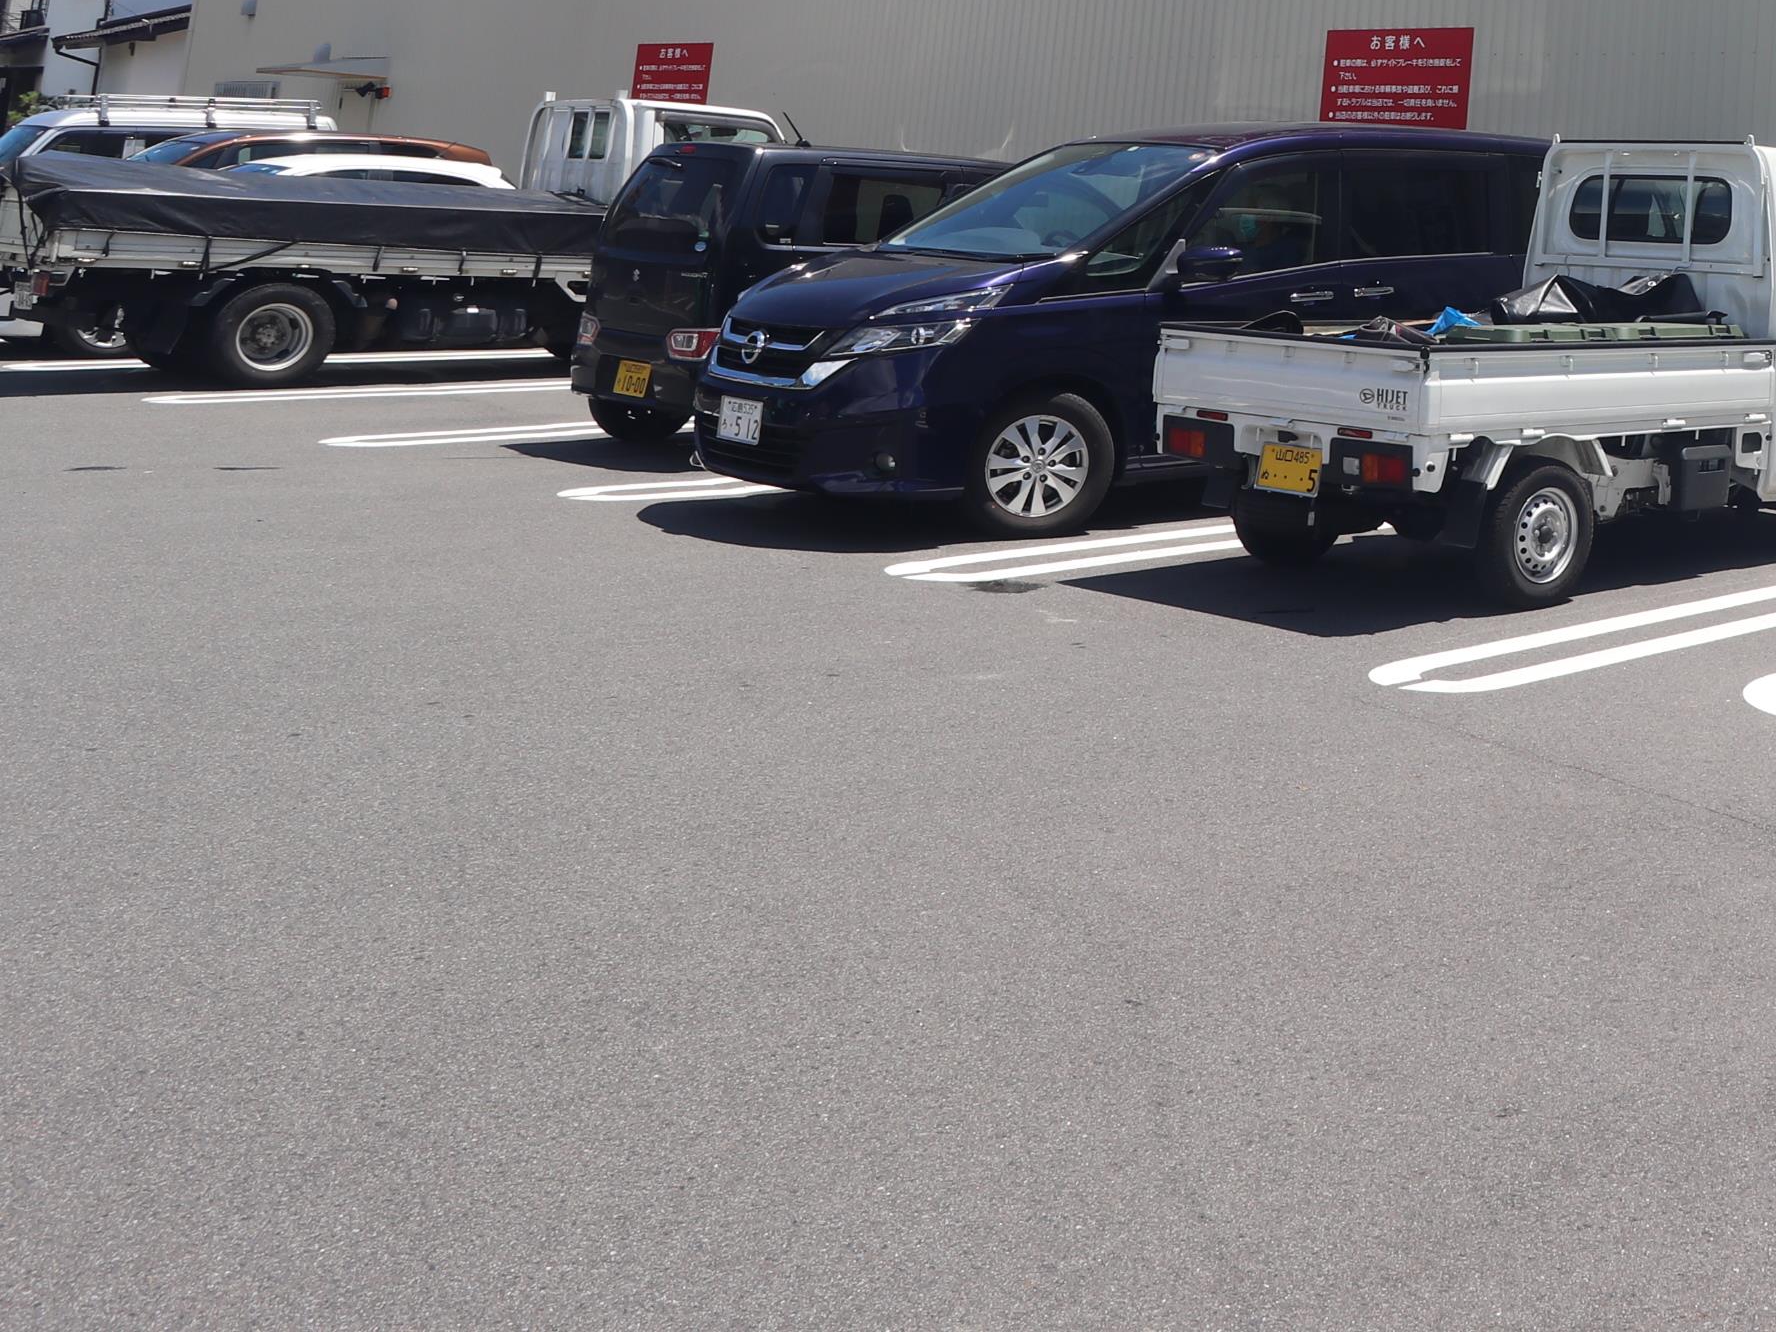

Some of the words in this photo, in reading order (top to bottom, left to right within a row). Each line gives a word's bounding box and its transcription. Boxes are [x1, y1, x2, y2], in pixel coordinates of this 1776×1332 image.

[1369, 34, 1426, 51] お客様へ
[1376, 388, 1408, 405] HIJET
[1376, 402, 1408, 412] TRUCK
